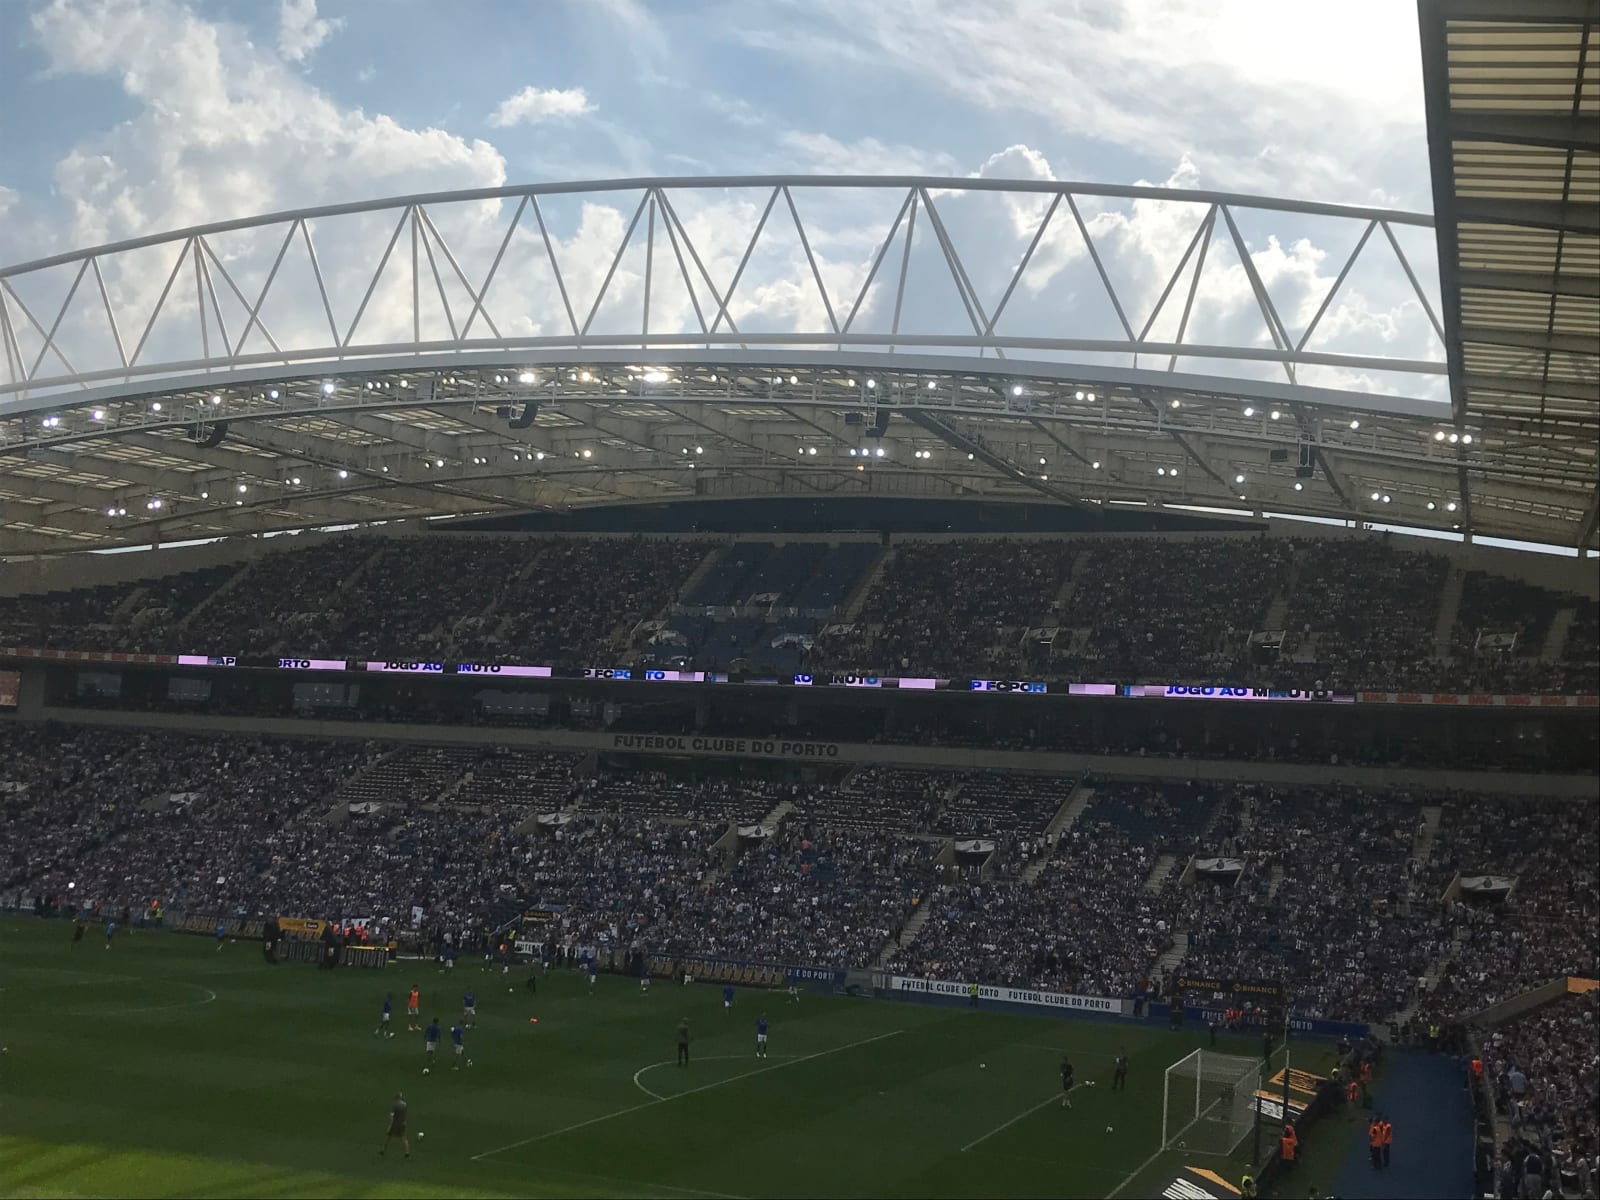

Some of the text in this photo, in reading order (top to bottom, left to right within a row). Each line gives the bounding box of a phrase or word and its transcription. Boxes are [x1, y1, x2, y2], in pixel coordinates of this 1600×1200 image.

[384, 662, 418, 670] JOGO
[422, 662, 443, 671] AO
[1166, 685, 1214, 696] JOGO
[1219, 687, 1248, 697] AO
[613, 734, 839, 757] FUTEBOL CLUBE DO PORTO
[1187, 980, 1221, 989] BINANCE
[1242, 985, 1278, 994] BINANCE
[937, 983, 960, 995] CLUBE
[1009, 990, 1042, 1003] FUTEBOL
[1045, 995, 1069, 1006] CLUBE
[1072, 997, 1082, 1007] DO
[1085, 999, 1111, 1010] PORTO
